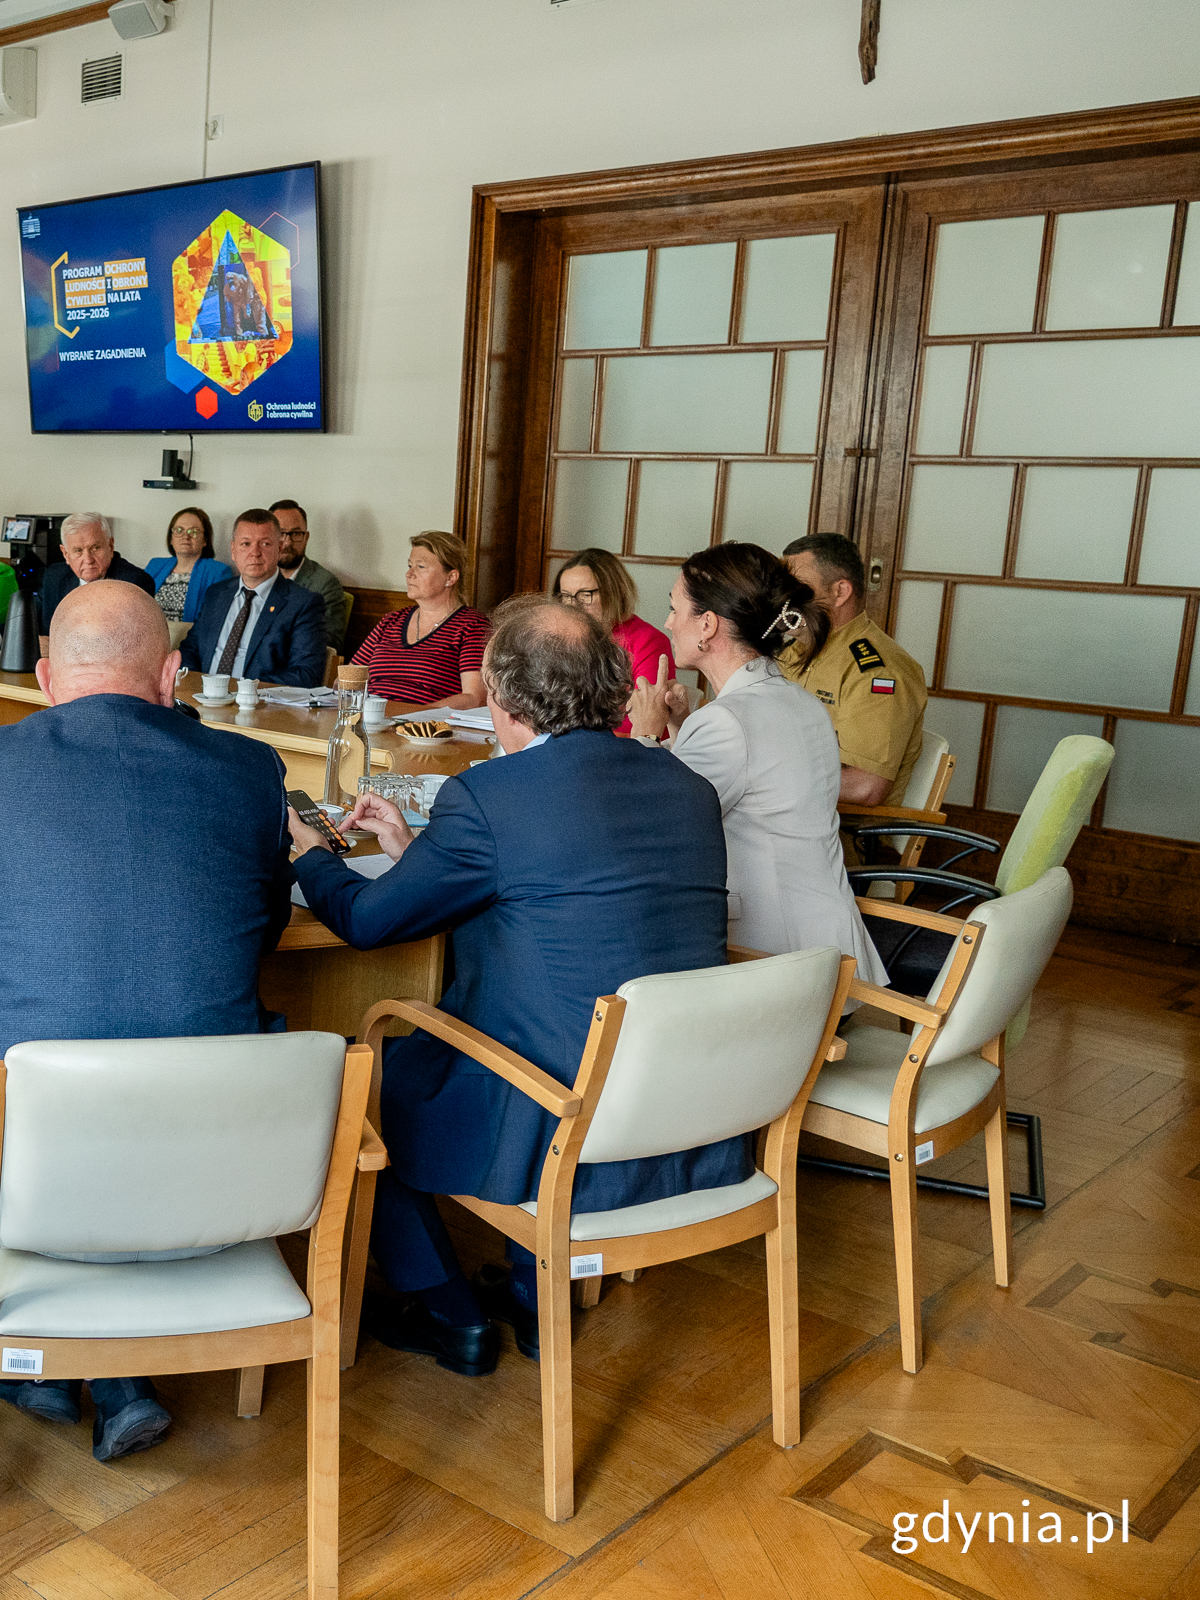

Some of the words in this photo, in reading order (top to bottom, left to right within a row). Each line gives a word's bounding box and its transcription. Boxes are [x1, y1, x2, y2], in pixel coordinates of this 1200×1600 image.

[63, 266, 102, 279] PROGRAM
[104, 261, 145, 274] OCHRONY
[65, 277, 105, 292] LUDNOŚCI
[107, 279, 111, 289] I
[112, 275, 148, 288] OBRONY
[66, 293, 106, 306] CYWILNEJ
[107, 292, 119, 303] NA
[120, 291, 141, 302] LATA
[59, 350, 94, 361] WYBRANE
[95, 348, 146, 360] ZAGADNIENIA
[266, 402, 291, 410] Ochrona
[291, 402, 316, 410] ludności
[290, 410, 313, 419] cywilna
